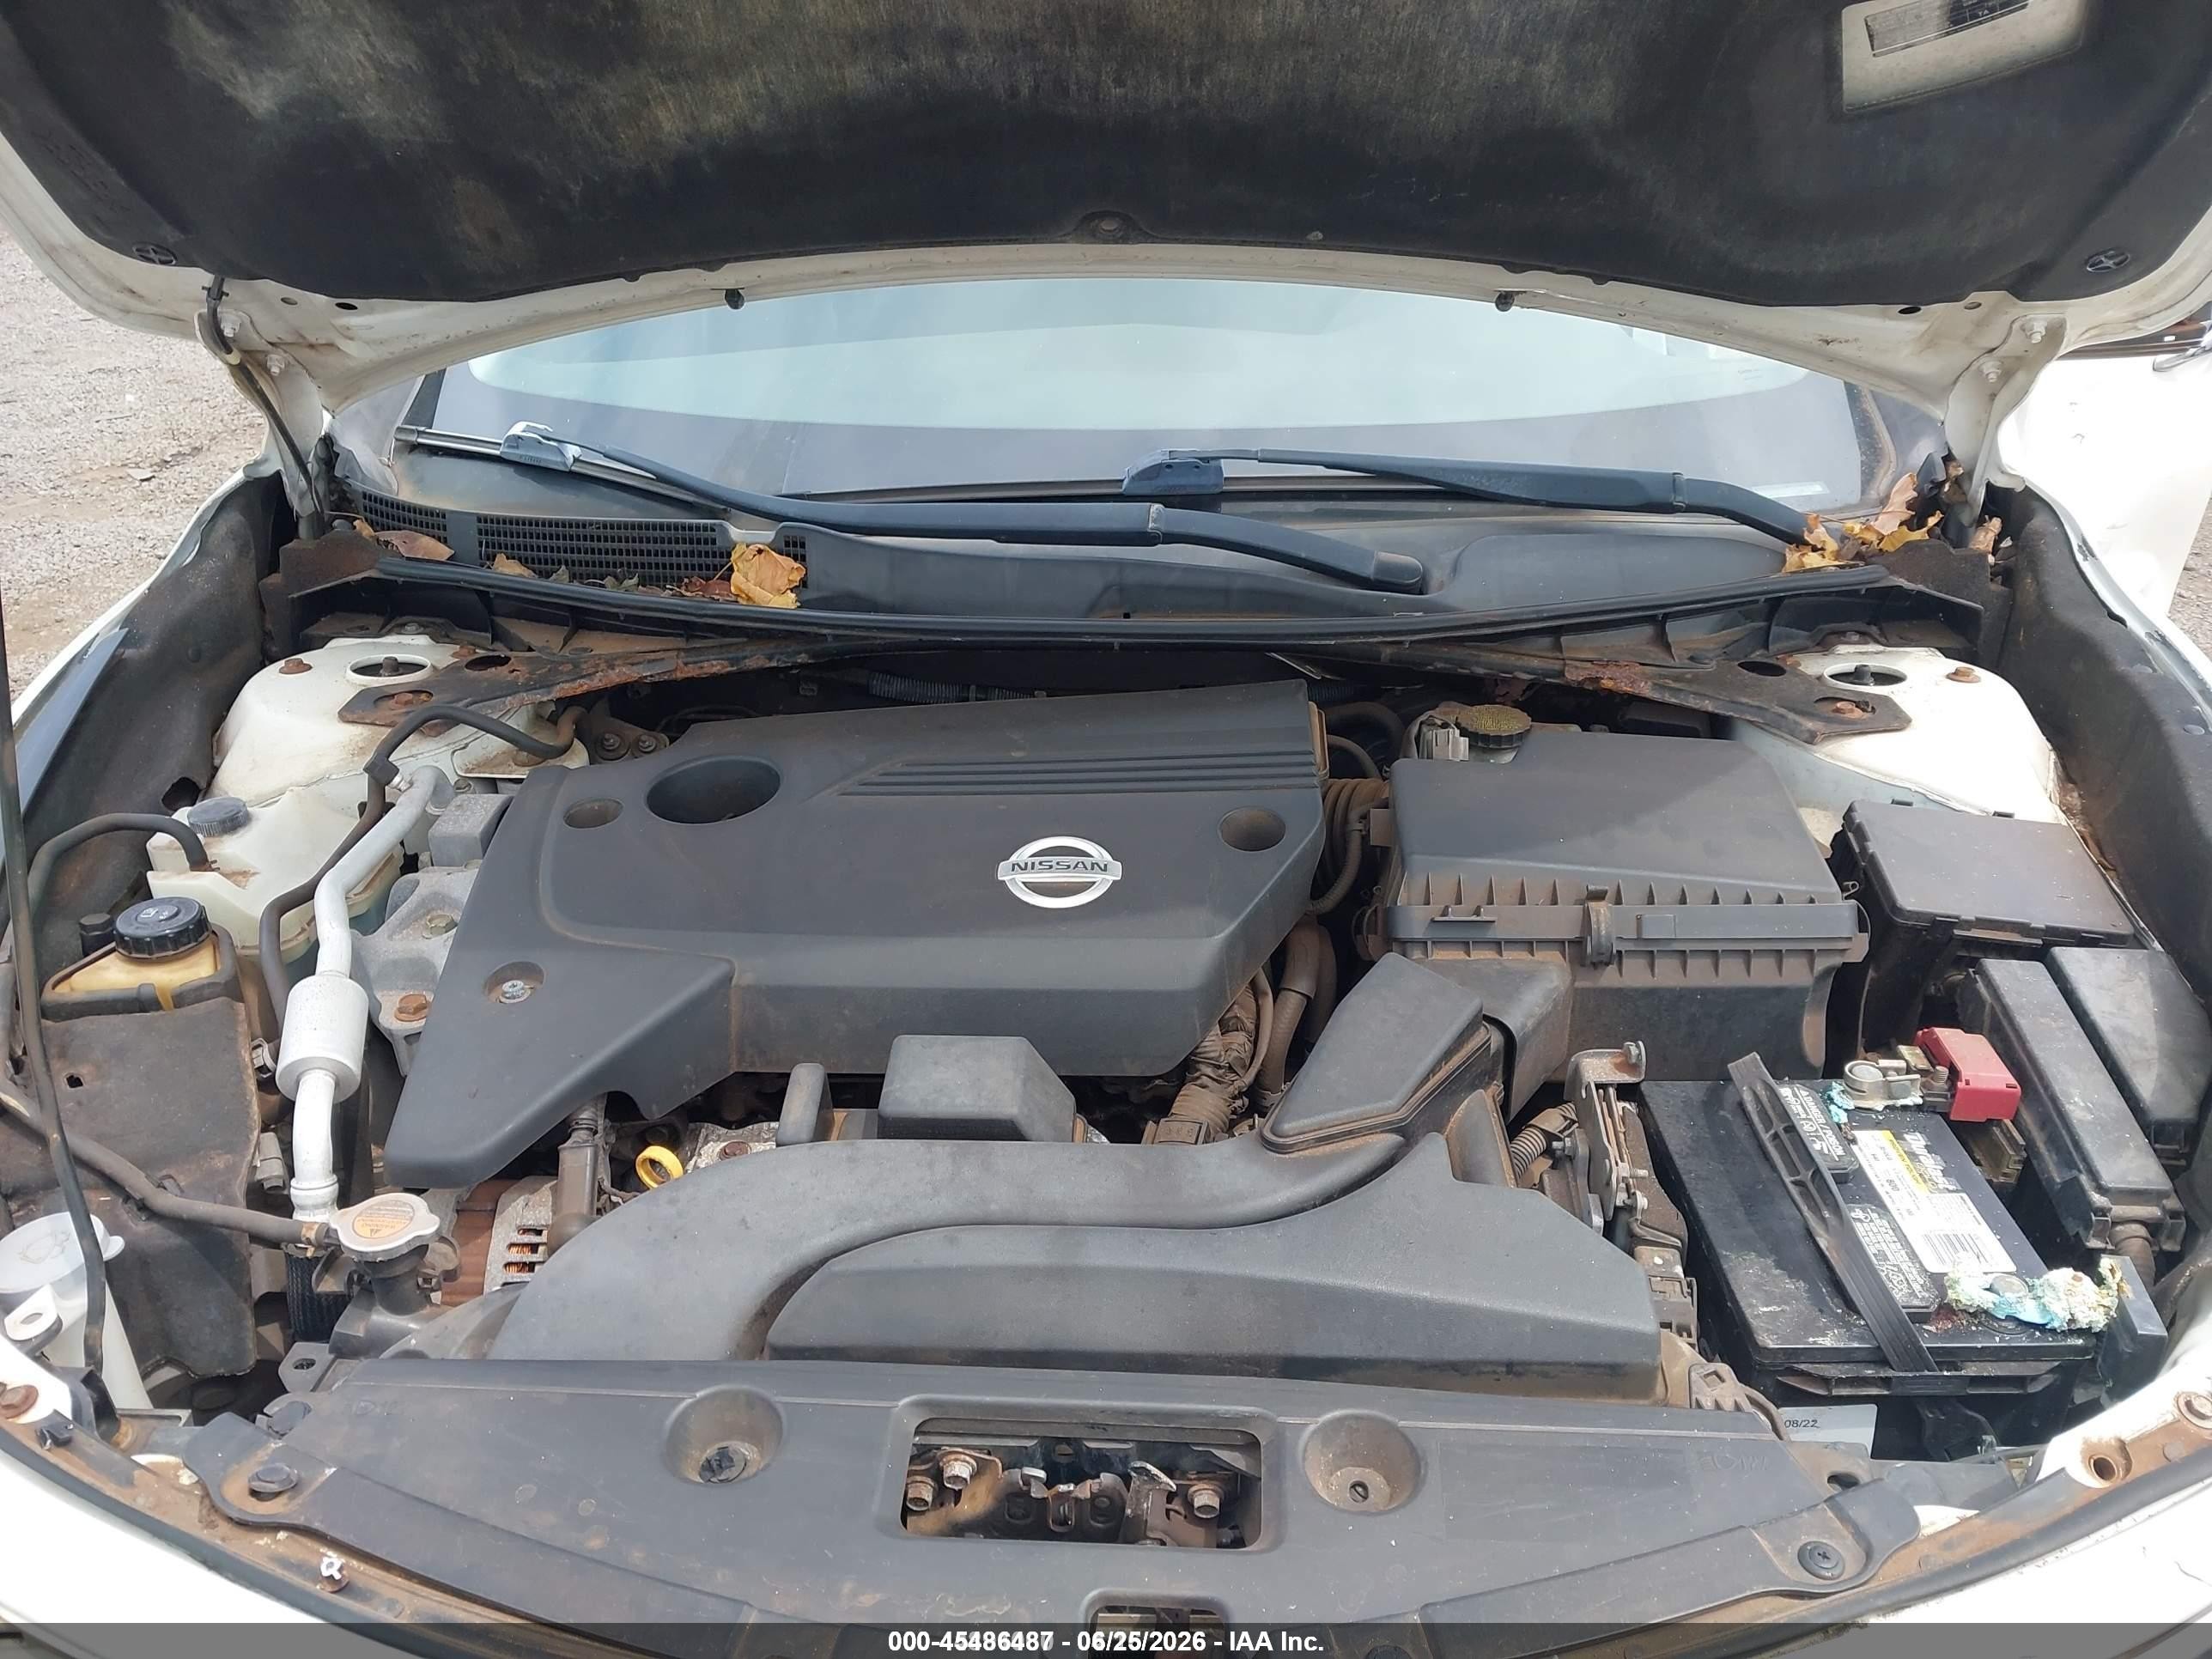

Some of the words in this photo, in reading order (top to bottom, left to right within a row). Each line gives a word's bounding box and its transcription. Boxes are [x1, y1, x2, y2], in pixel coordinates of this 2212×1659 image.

[1011, 860, 1109, 872] NISSAN
[1904, 1132, 1959, 1191] Duralast
[1784, 1419, 1820, 1429] 08/22
